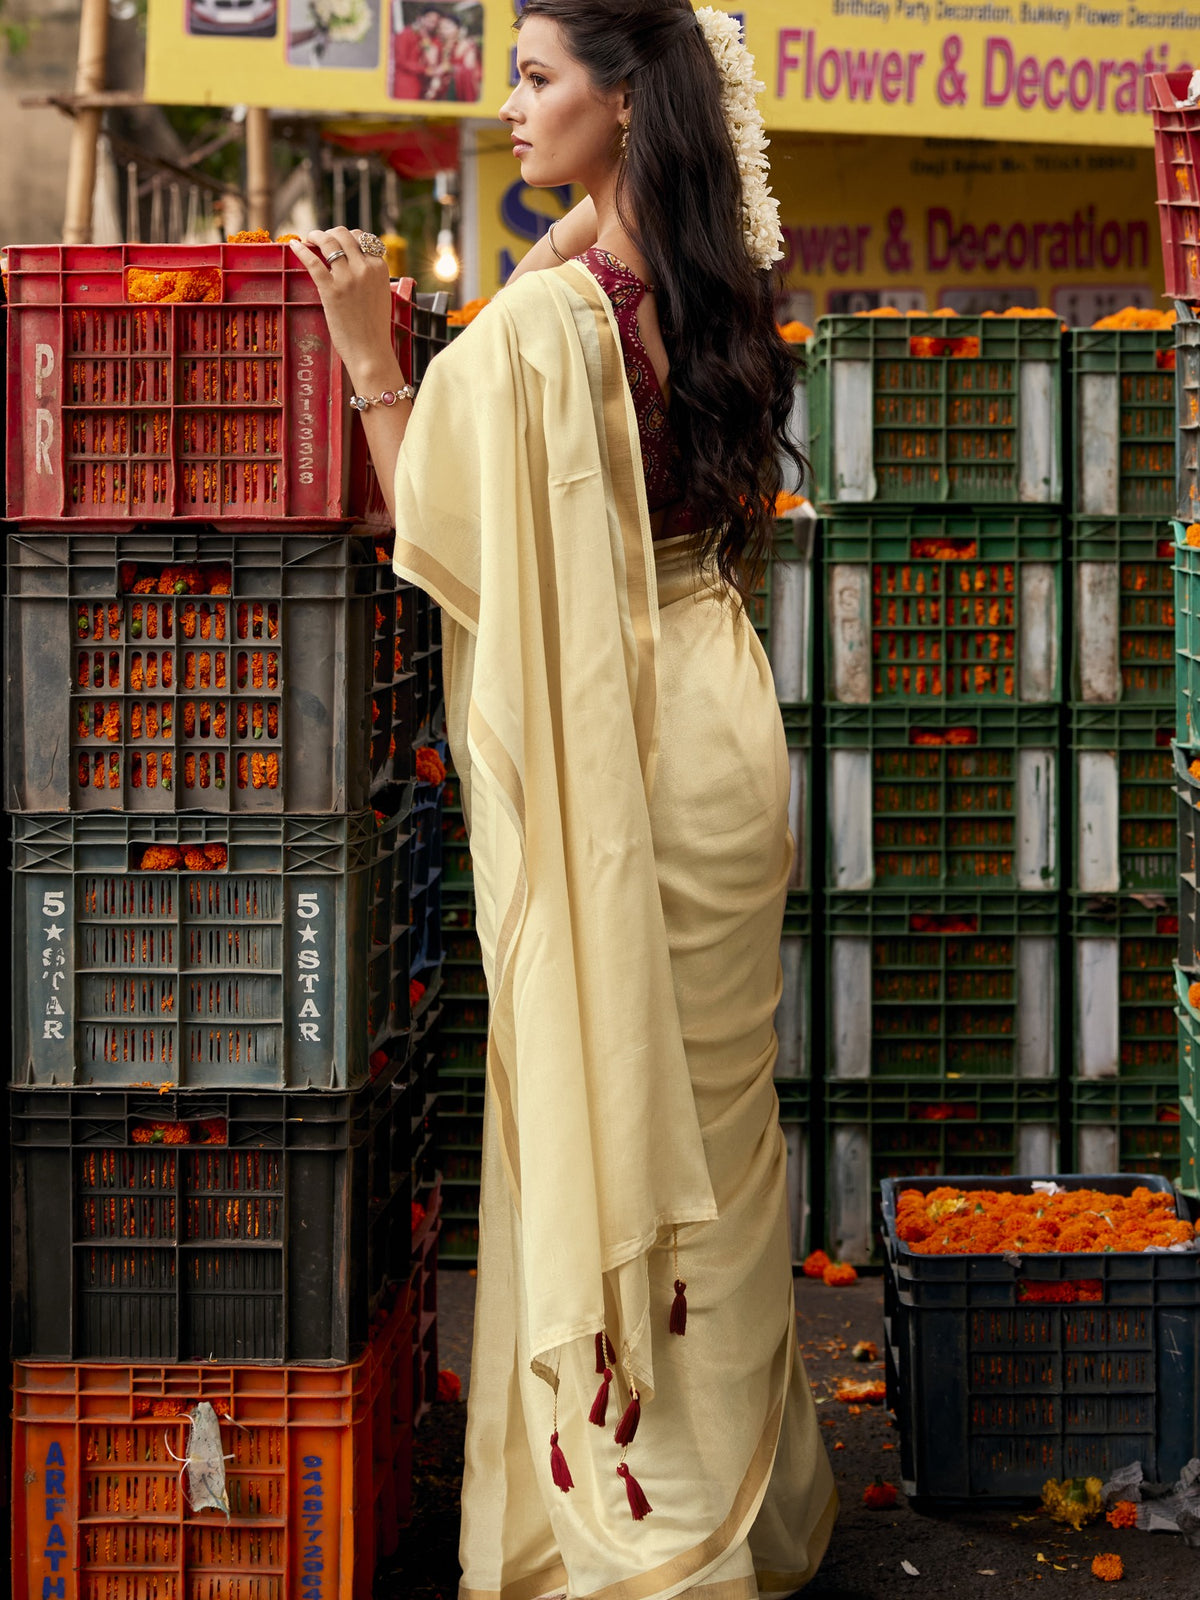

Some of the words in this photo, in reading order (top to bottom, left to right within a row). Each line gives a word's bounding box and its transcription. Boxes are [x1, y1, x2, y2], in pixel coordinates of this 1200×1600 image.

[832, 0, 890, 22] Birthday
[896, 2, 931, 25] Party
[1076, 5, 1121, 26] Flower
[776, 28, 924, 104] Flower
[937, 34, 968, 107] &
[984, 36, 1193, 115] Decorati
[883, 206, 914, 273] &
[926, 203, 1150, 273] Decoration
[42, 891, 65, 917] 5
[297, 893, 320, 919] 5
[298, 949, 321, 1042] STAR
[42, 1441, 67, 1600] ARFATH
